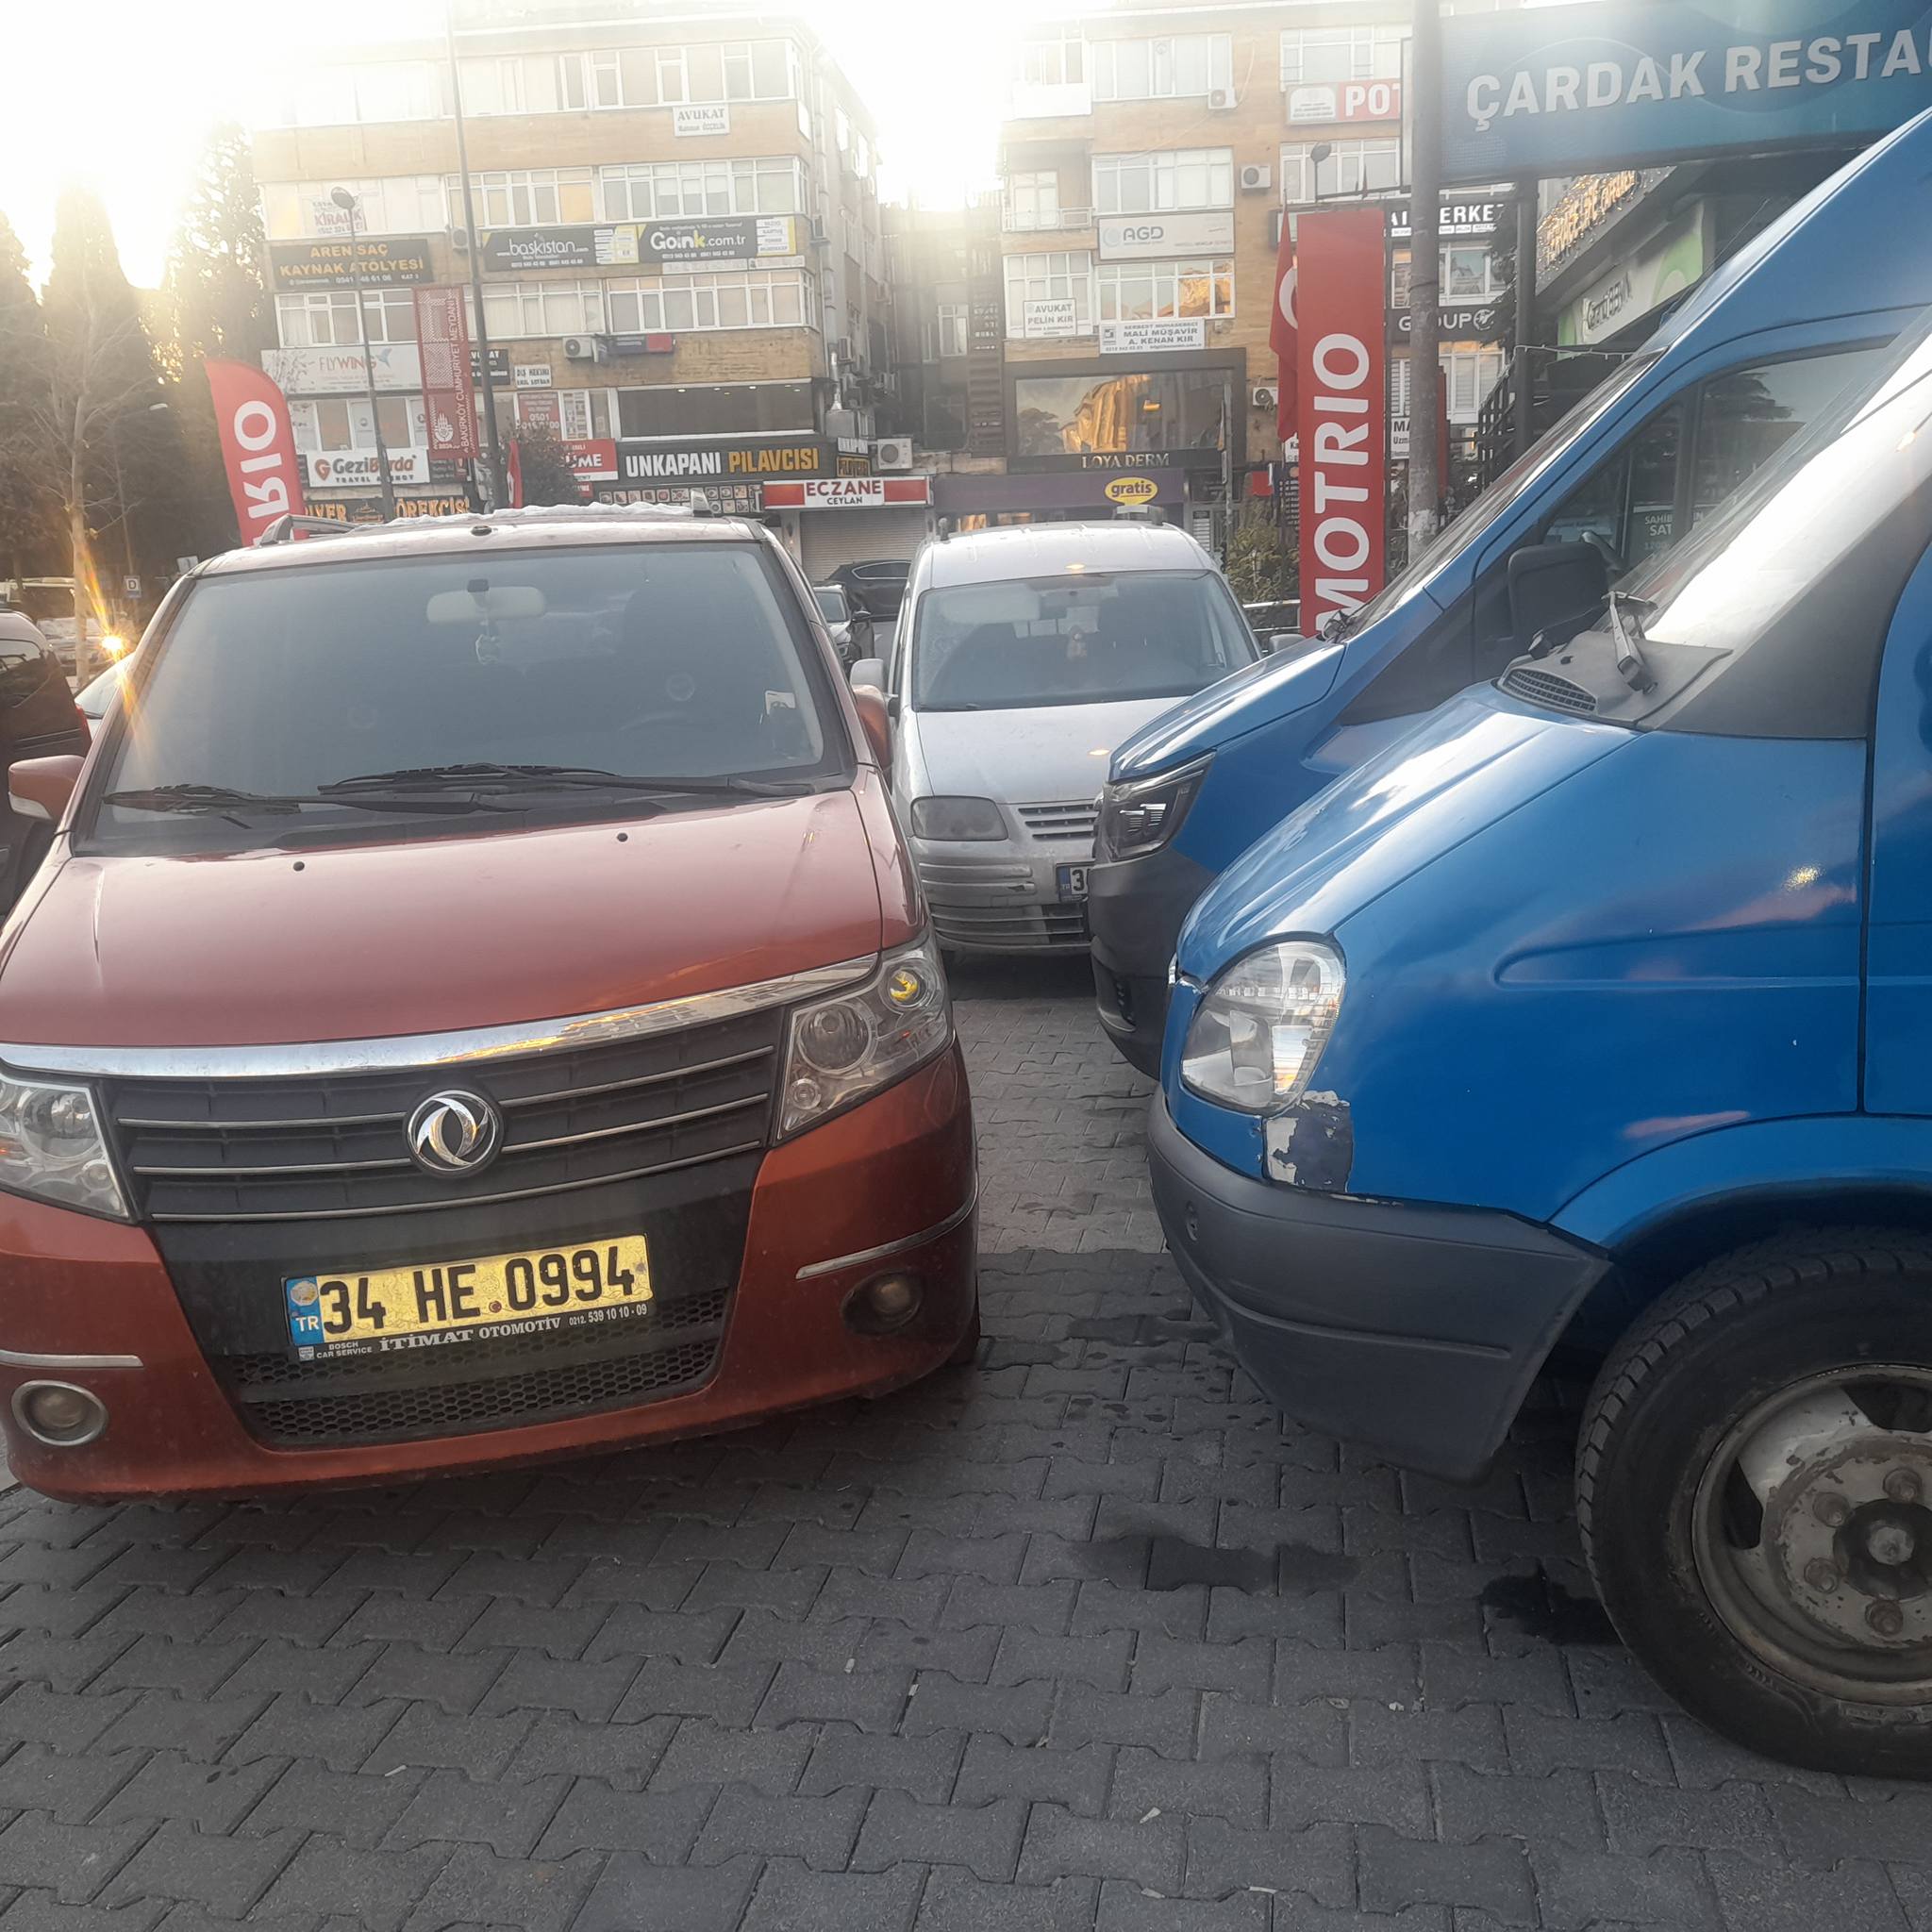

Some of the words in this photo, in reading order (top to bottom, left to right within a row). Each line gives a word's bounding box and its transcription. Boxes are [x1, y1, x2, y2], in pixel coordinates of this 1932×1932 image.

[1466, 53, 1707, 132] ÇARDAK
[1724, 29, 1932, 93] RESTA
[678, 108, 724, 121] AVUKAT
[315, 208, 362, 226] KİRALK
[1123, 226, 1164, 242] AGD
[310, 245, 352, 258] AREN
[358, 243, 389, 257] SAÇ
[280, 263, 344, 276] KAYNAK
[1035, 303, 1073, 313] AVUKAT
[1124, 328, 1149, 337] MALİ
[1141, 337, 1174, 345] KENAN
[333, 455, 413, 475] GeziBrda
[625, 451, 722, 477] UNKAPANI
[1082, 456, 1123, 469] LOYA
[1125, 453, 1170, 467] DERM
[806, 480, 882, 496] ECZANE
[1111, 480, 1152, 497] gratis
[1313, 333, 1370, 645] MOTRIO
[826, 497, 863, 506] CEYLAN
[128, 580, 137, 590] D
[1072, 869, 1085, 891] 3
[295, 1316, 320, 1332] TR
[319, 1277, 387, 1335] 34
[413, 1264, 481, 1324] HE
[505, 1246, 635, 1311] 0994
[379, 1328, 474, 1352] İTİMAT
[478, 1316, 561, 1339] OTOMOTİV
[588, 1309, 604, 1324] 539
[606, 1307, 617, 1321] 10
[619, 1306, 629, 1319] 10
[636, 1304, 647, 1315] 09
[316, 1351, 334, 1359] CAR
[336, 1346, 373, 1357] SERVICE
[328, 1341, 358, 1350] BOSCH
